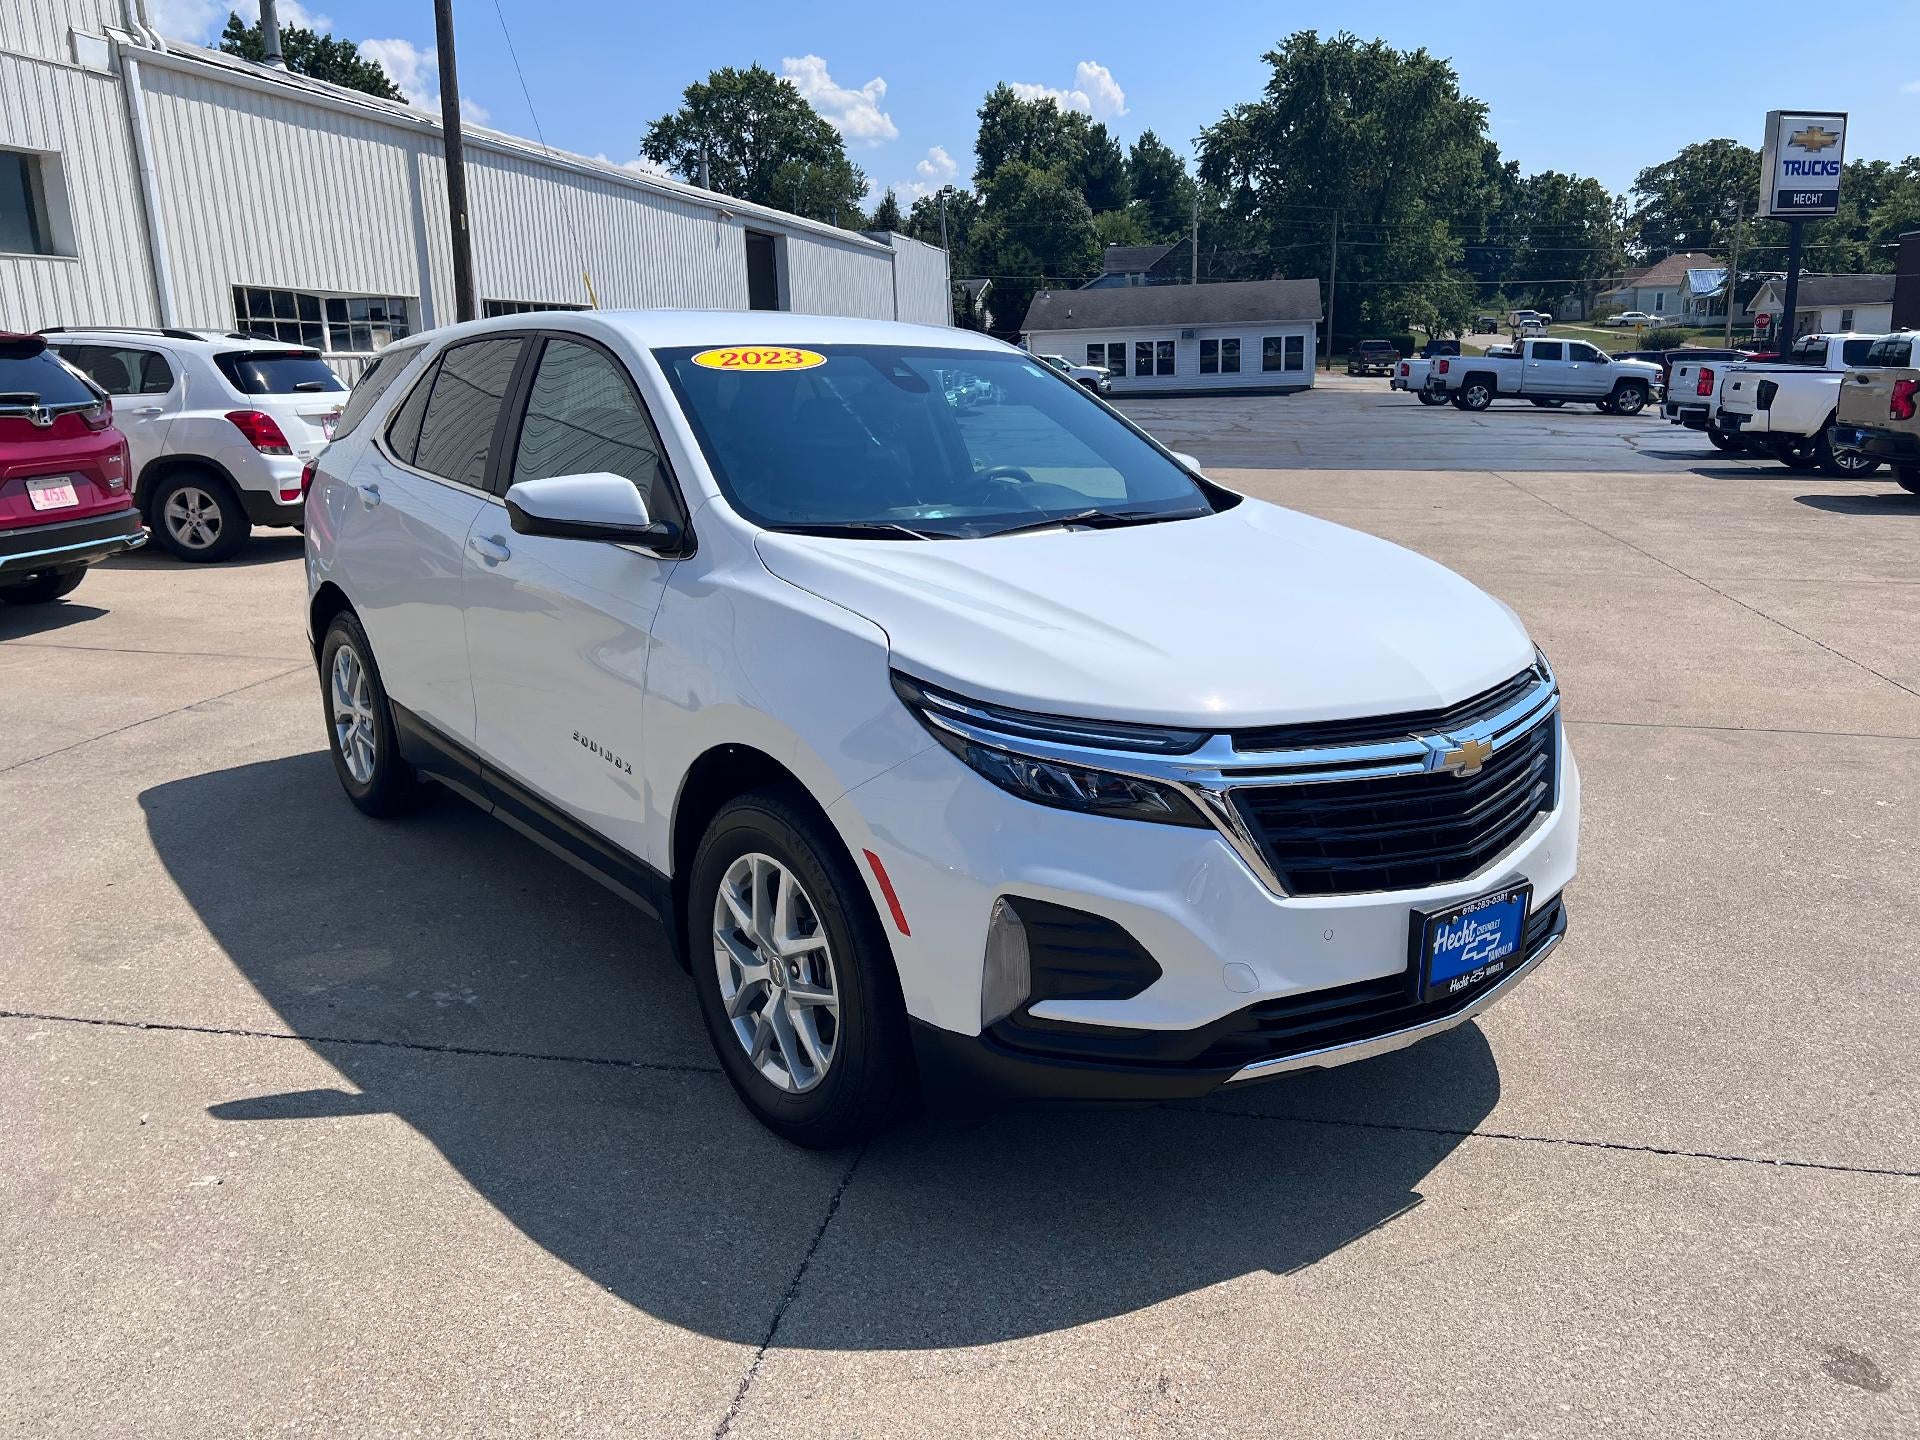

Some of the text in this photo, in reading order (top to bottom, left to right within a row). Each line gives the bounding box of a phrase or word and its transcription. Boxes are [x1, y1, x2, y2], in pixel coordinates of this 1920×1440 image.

[1783, 160, 1840, 176] TRUCKS
[1793, 193, 1823, 204] HECHT
[1755, 317, 1770, 325] STOP
[720, 351, 804, 366] 2023
[573, 729, 632, 775] EQUINOX
[1433, 919, 1477, 954] Hecht
[1449, 976, 1470, 993] Hecht
